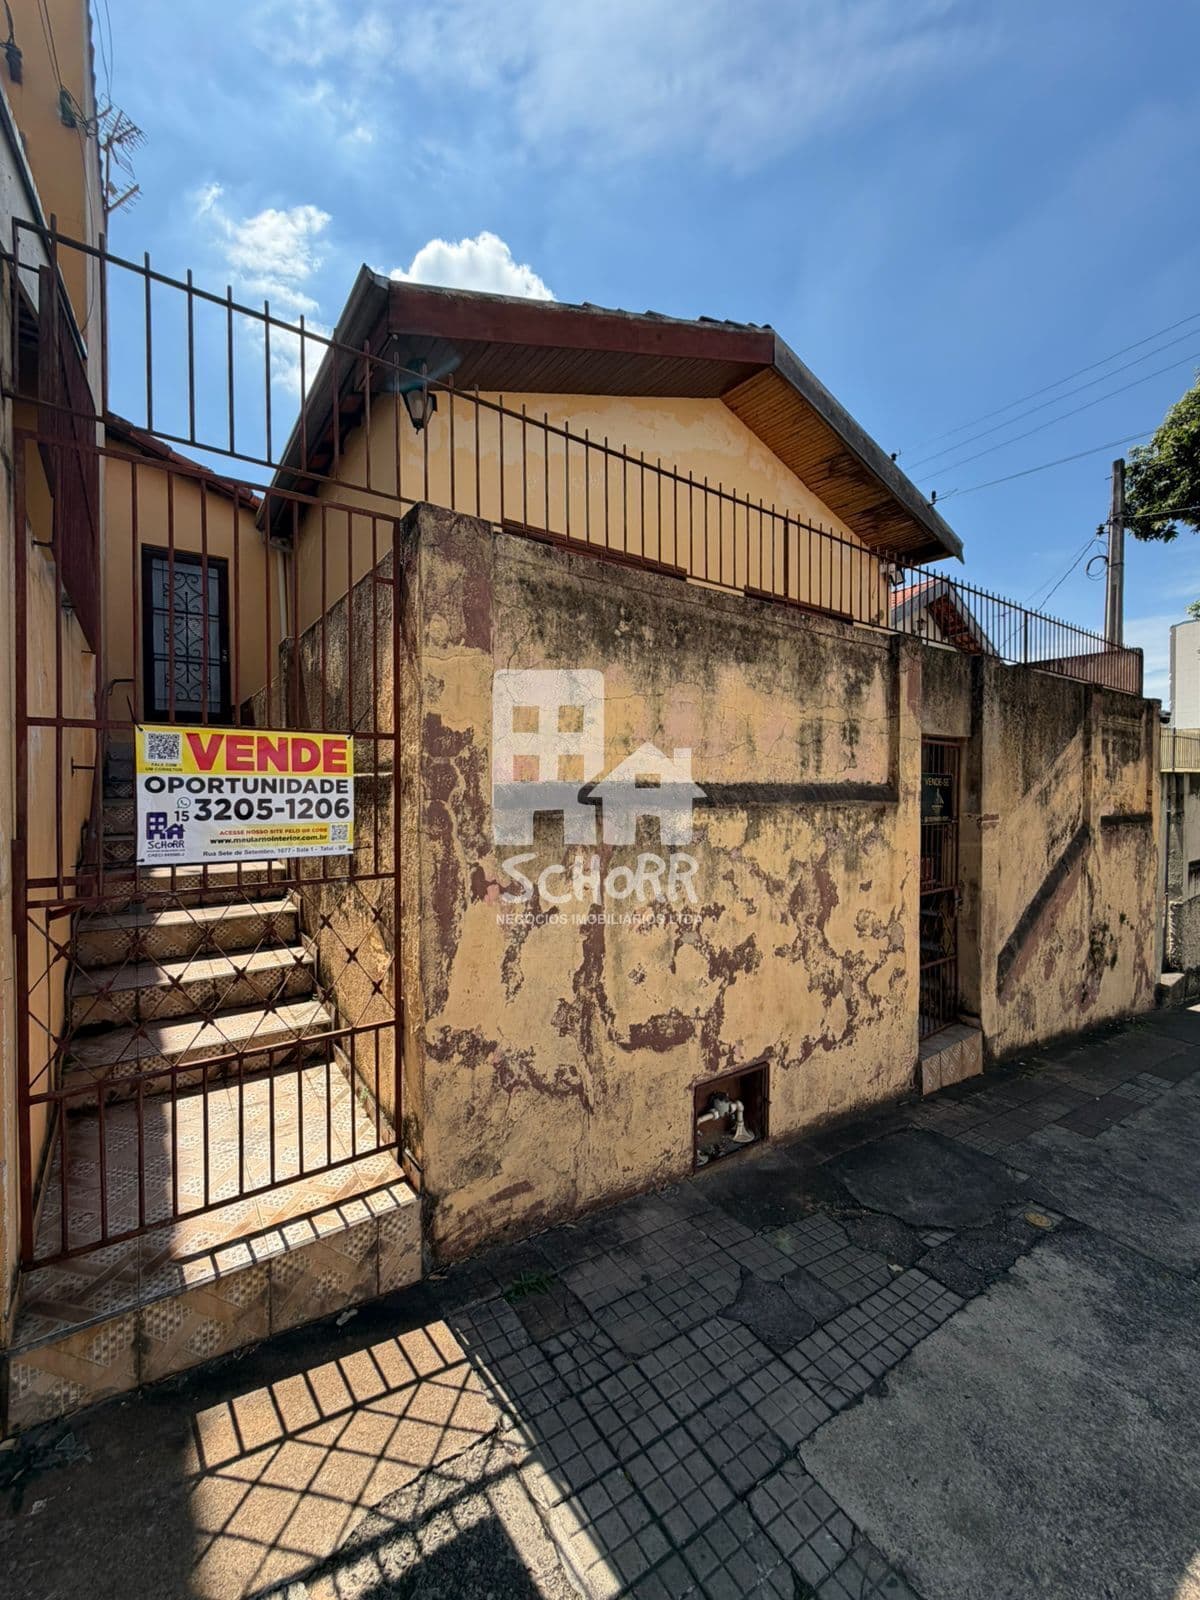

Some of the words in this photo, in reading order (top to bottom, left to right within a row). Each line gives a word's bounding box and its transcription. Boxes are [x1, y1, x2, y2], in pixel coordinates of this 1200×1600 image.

[185, 732, 348, 773] VENDE
[144, 776, 349, 794] OPORTUNIDADE
[174, 810, 190, 822] 15
[194, 797, 350, 821] 3205-1206
[209, 834, 328, 845] www.meularnointerior.com.br
